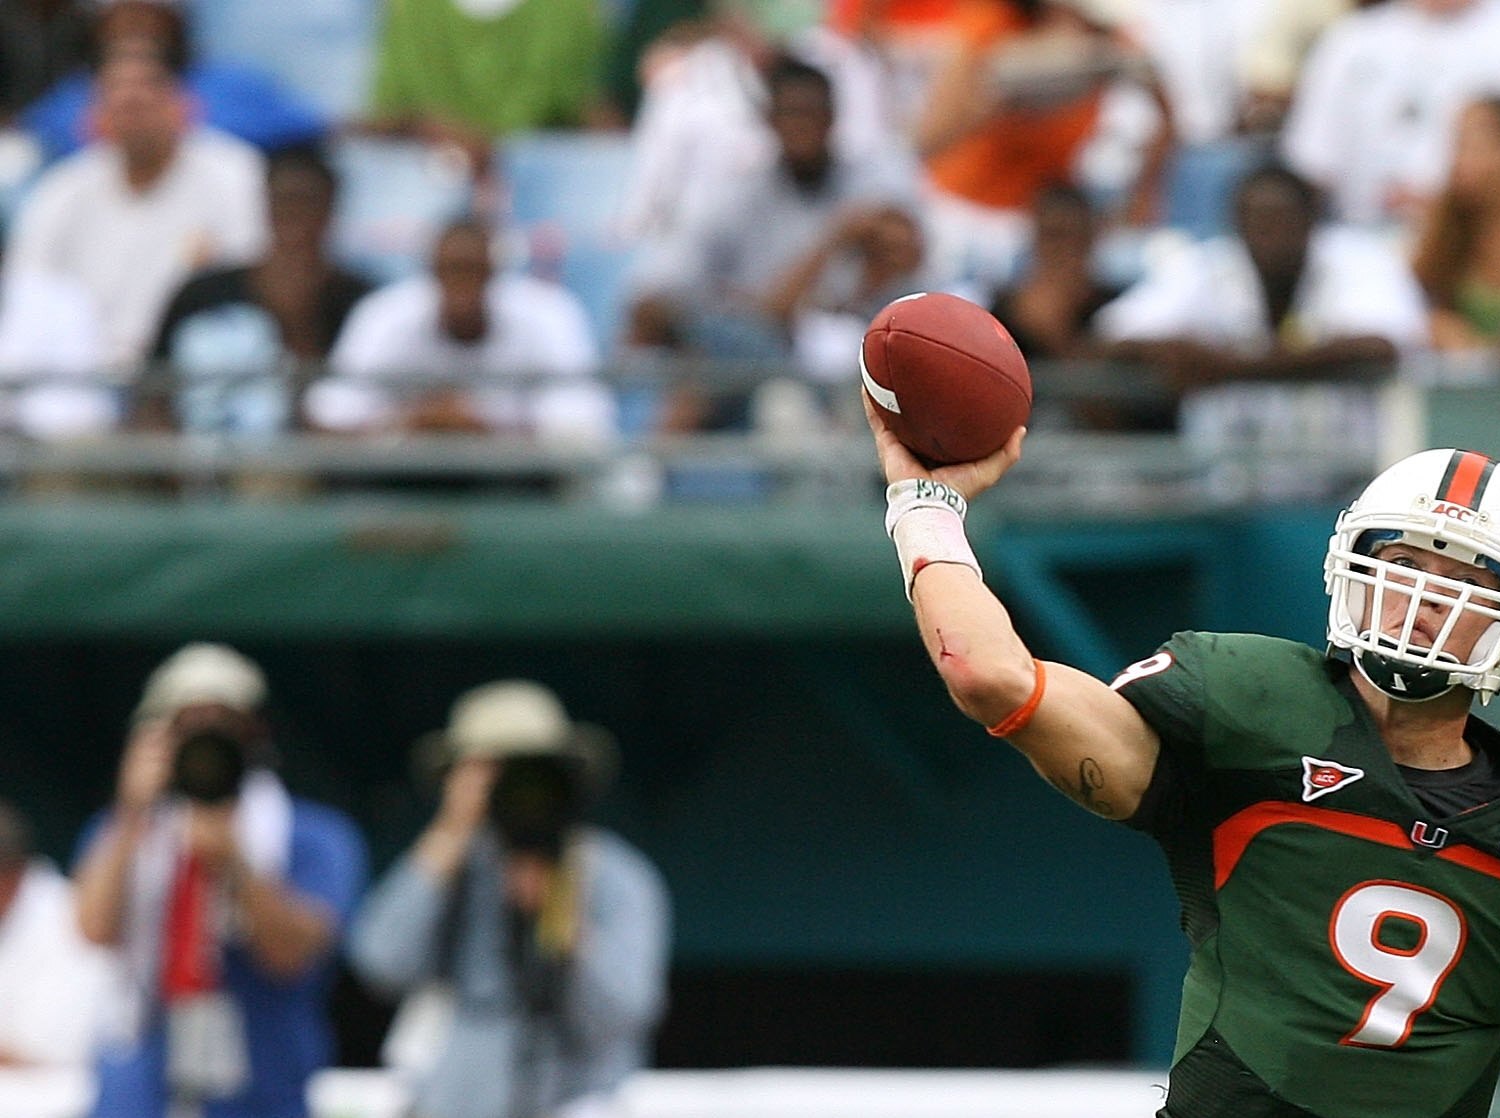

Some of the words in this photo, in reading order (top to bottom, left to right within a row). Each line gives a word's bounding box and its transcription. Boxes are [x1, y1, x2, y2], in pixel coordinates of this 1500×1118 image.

[1431, 503, 1475, 523] ACC
[1110, 649, 1176, 692] 9
[1328, 878, 1470, 1048] 9
